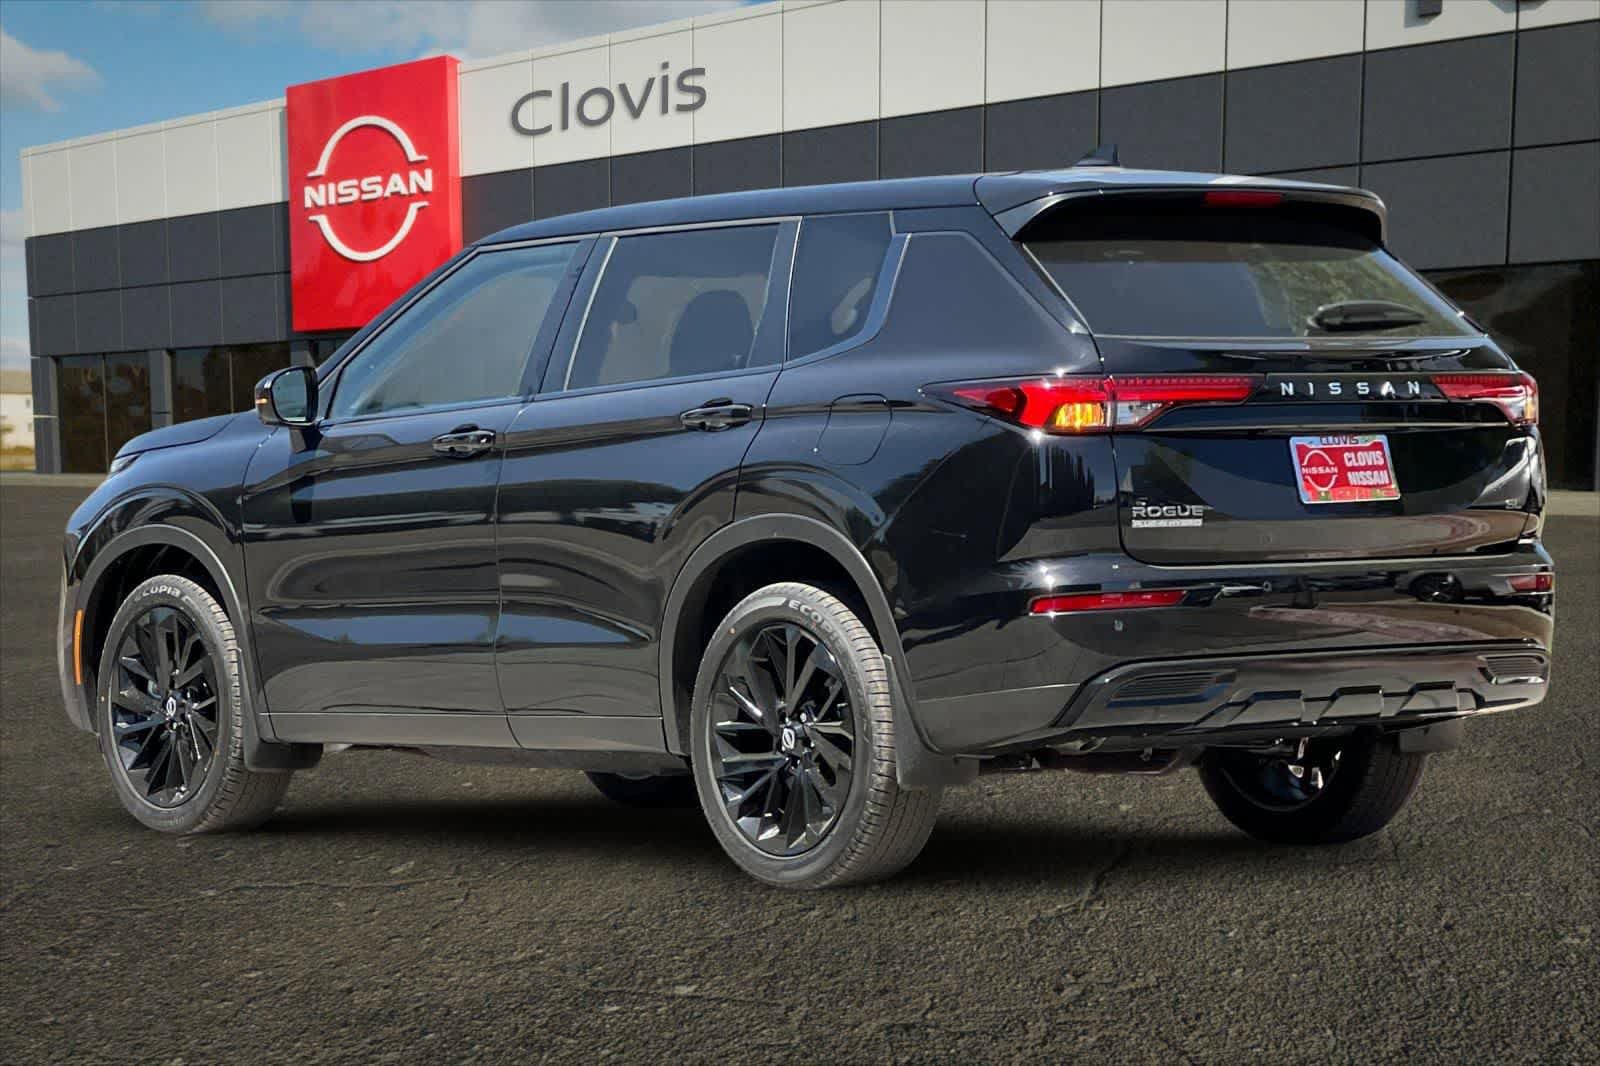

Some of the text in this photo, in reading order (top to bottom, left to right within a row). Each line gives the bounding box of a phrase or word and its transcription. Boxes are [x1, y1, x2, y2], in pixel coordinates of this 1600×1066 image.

[510, 61, 707, 136] Clovis
[303, 168, 433, 208] NISSAN
[1280, 381, 1421, 397] NISSAN
[1320, 435, 1359, 446] CLOVIS
[1343, 450, 1385, 467] CLOVIS
[1301, 466, 1338, 475] NISSAN
[1347, 470, 1390, 486] NISSAN
[1131, 505, 1204, 517] ROGUE
